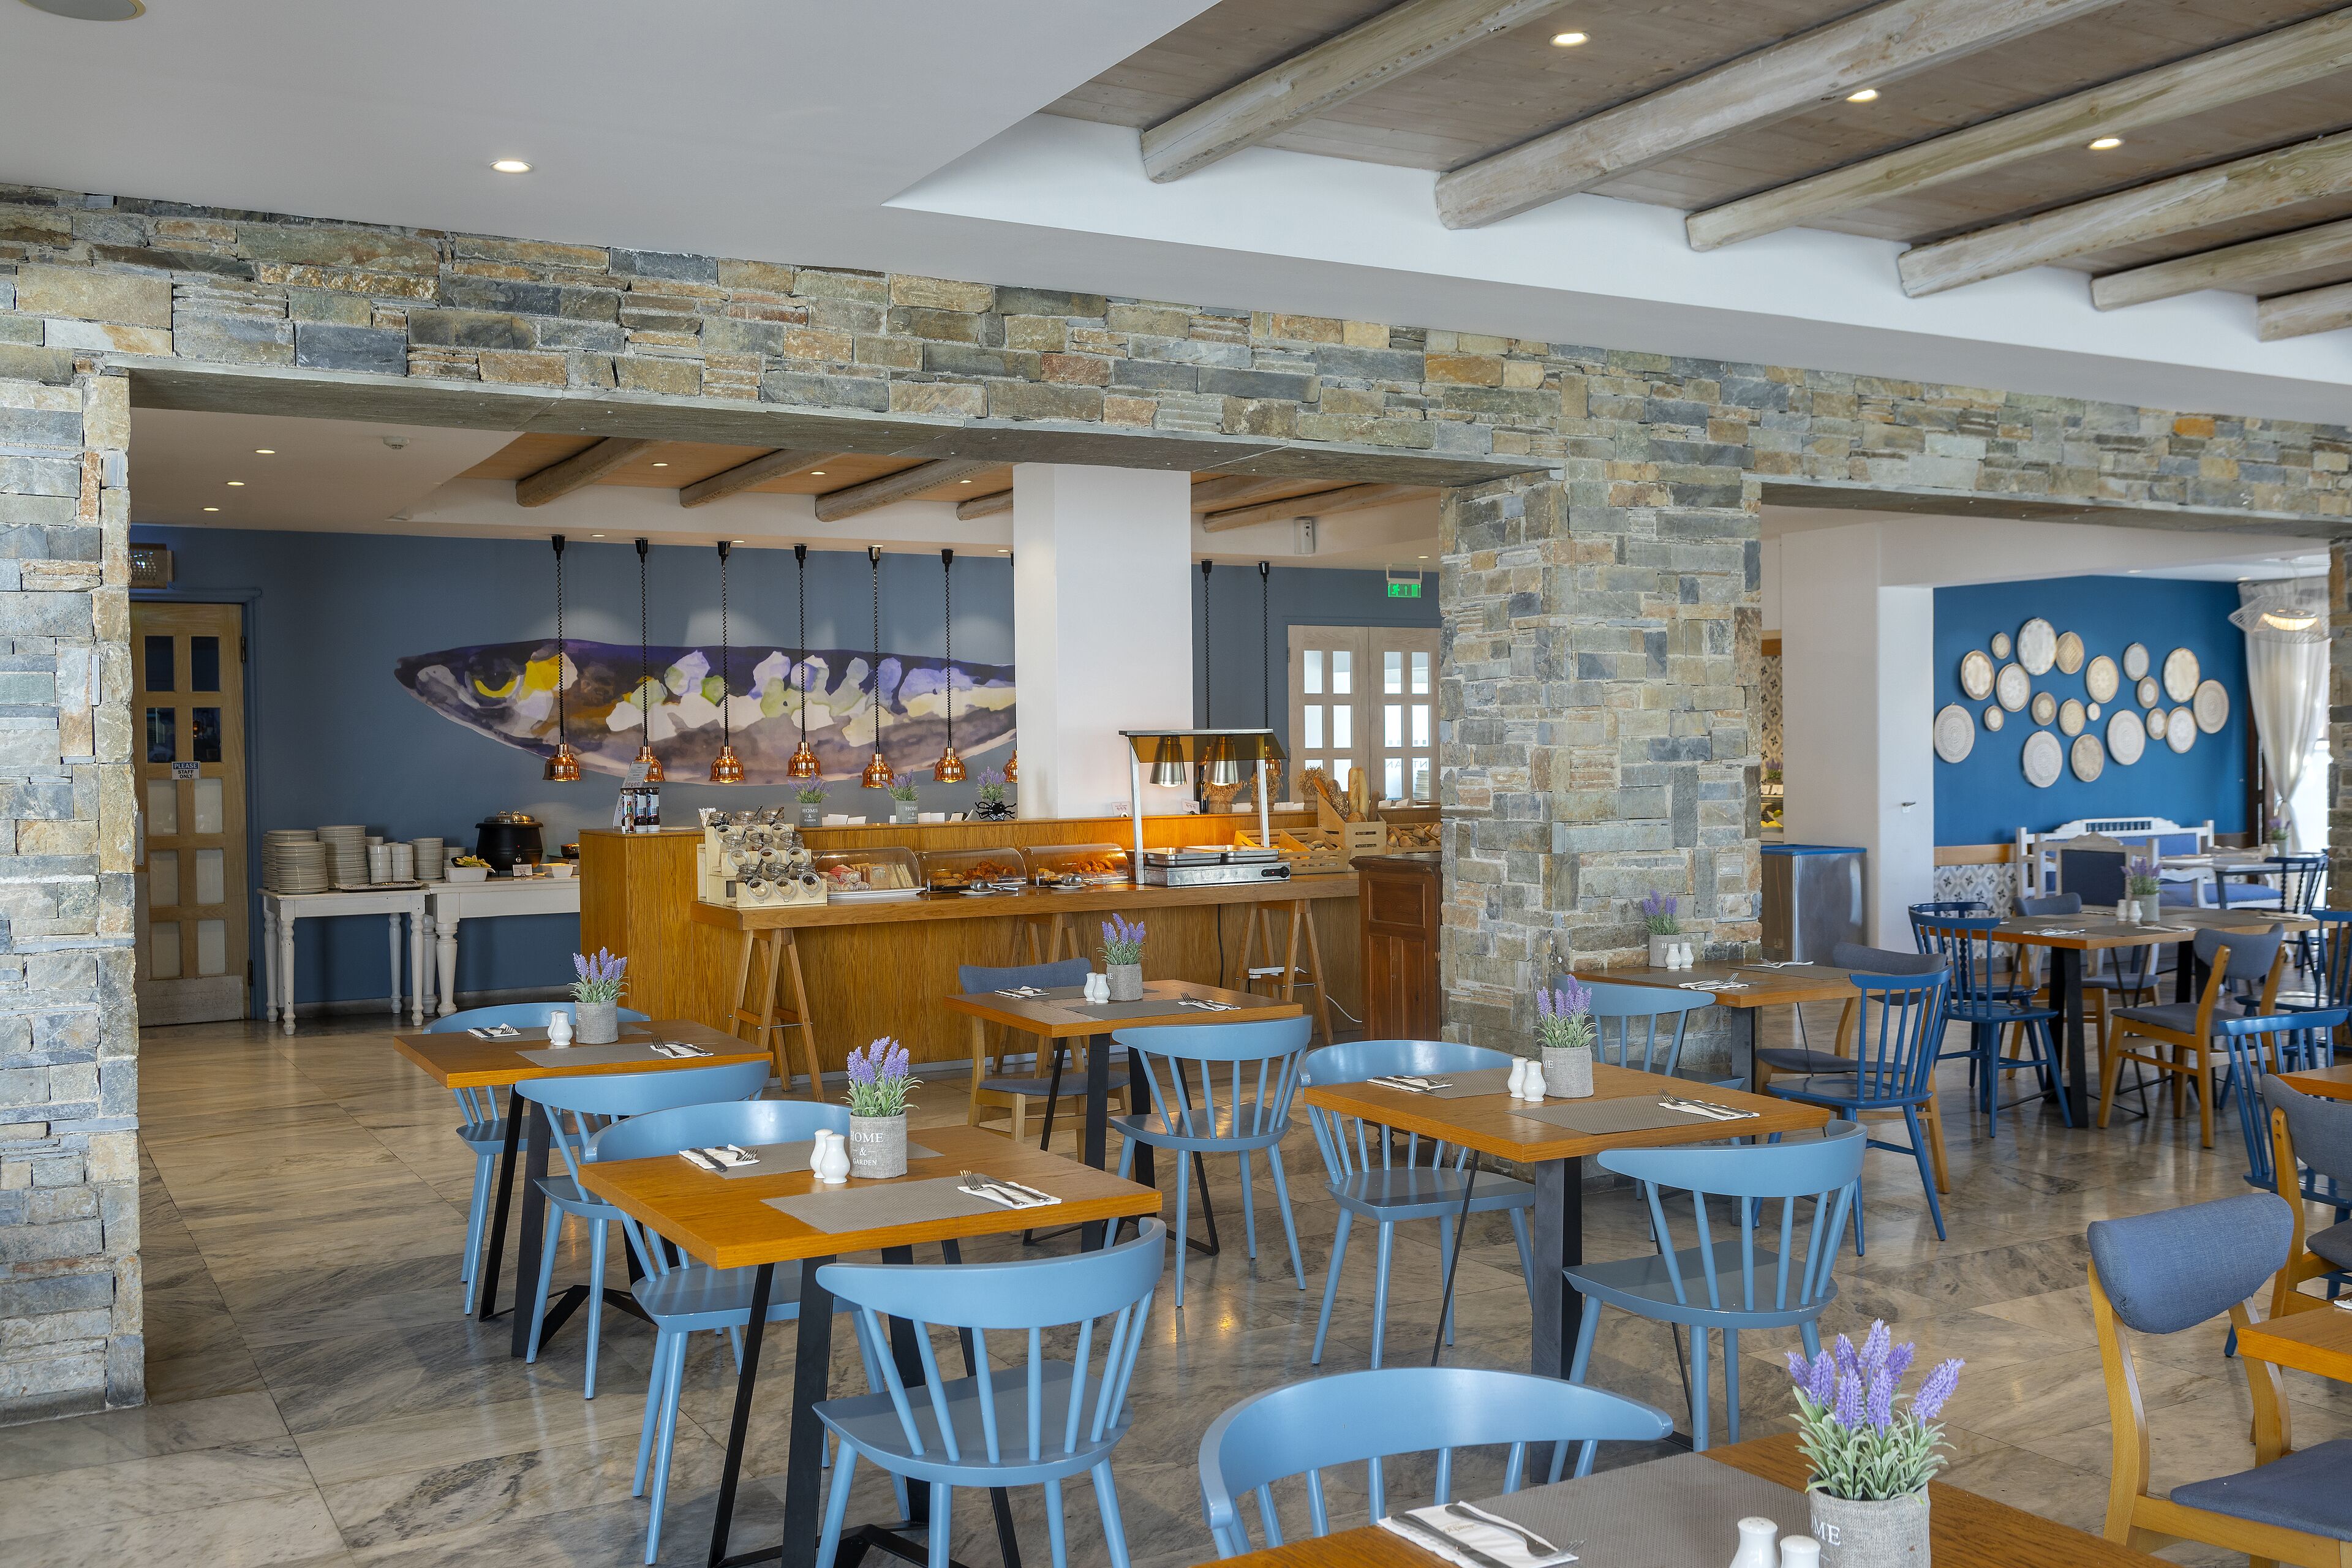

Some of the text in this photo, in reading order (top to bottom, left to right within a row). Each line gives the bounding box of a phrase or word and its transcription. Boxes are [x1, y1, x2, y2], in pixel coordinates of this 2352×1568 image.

[850, 1131, 884, 1143] HOME
[859, 1147, 867, 1156] &
[1811, 1509, 1841, 1547] ME
